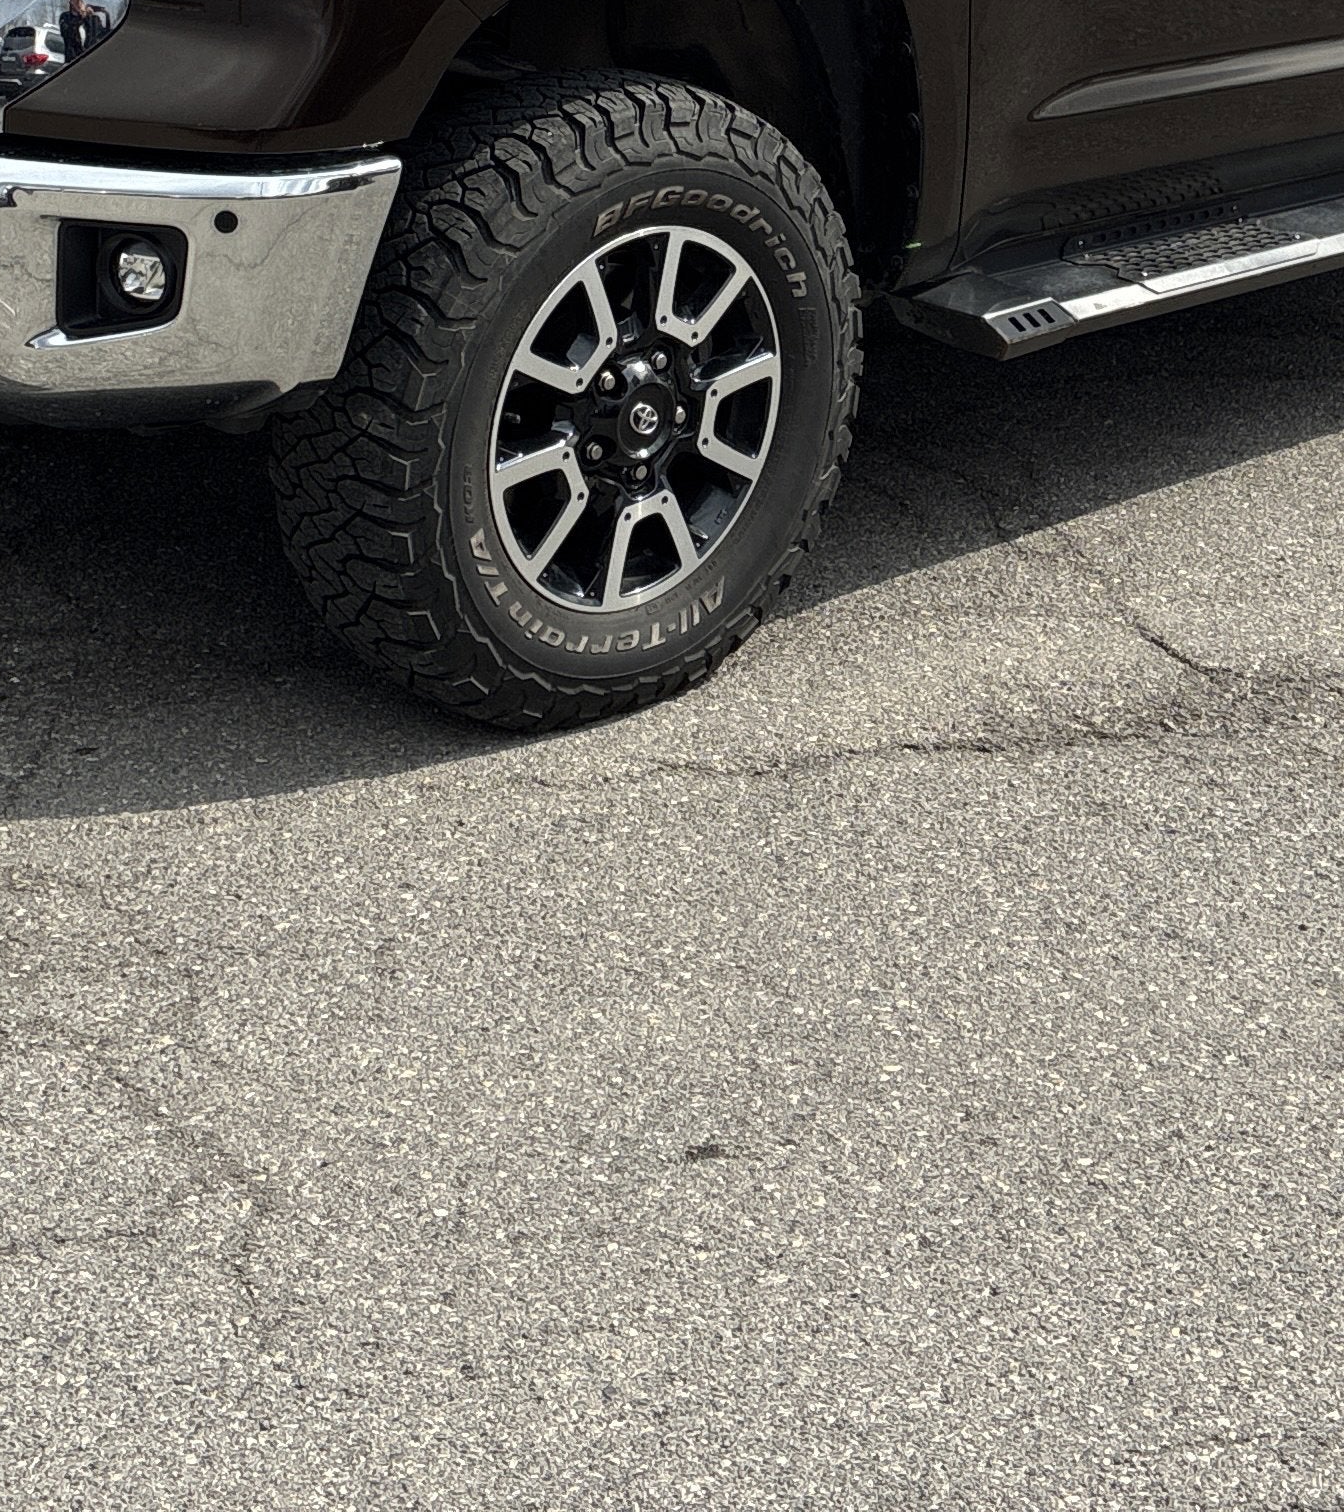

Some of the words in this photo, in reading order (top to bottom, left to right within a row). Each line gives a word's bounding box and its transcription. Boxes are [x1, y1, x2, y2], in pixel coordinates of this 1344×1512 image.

[593, 185, 807, 298] BFGoodrich
[470, 528, 509, 606] T/A
[508, 575, 725, 655] All-Terrain
